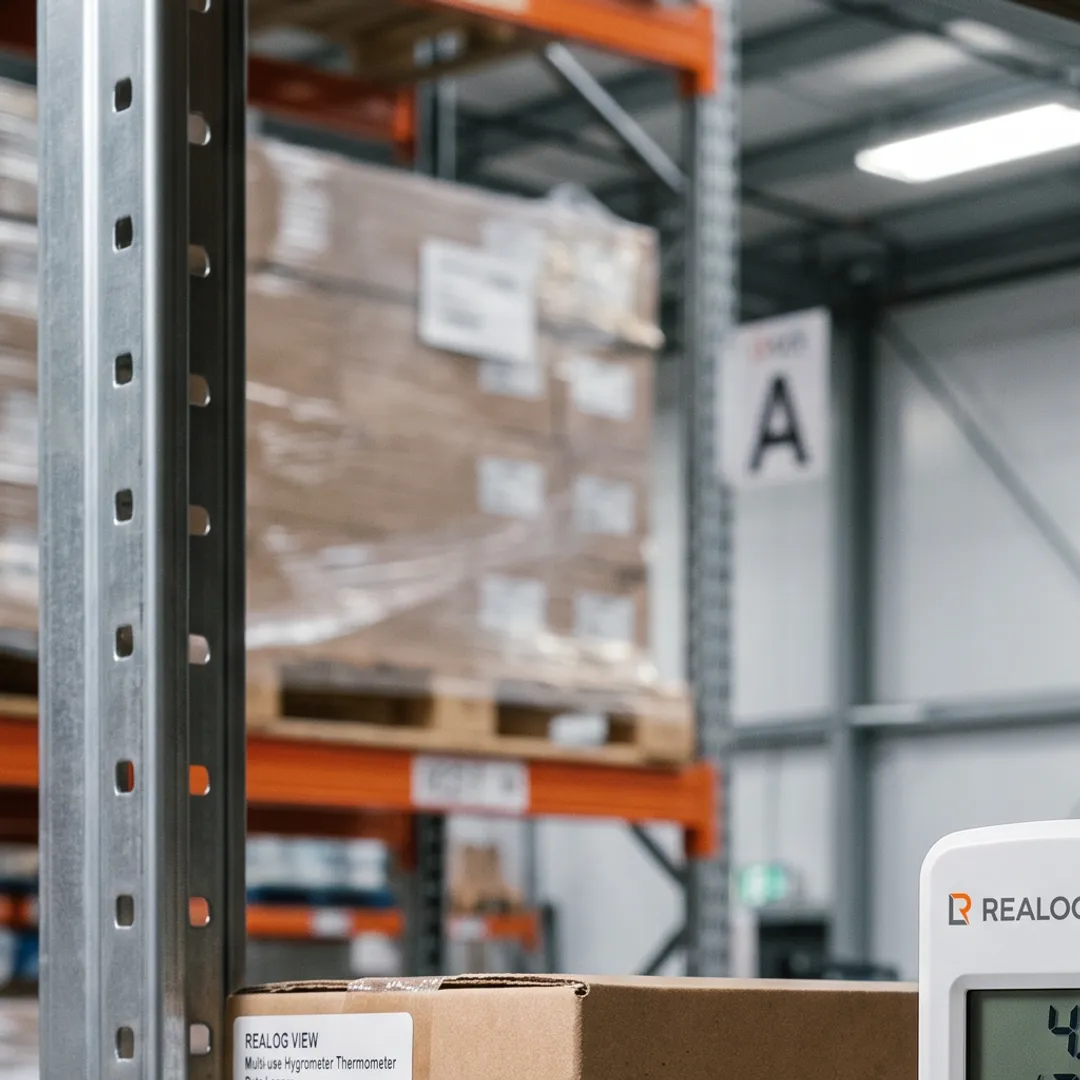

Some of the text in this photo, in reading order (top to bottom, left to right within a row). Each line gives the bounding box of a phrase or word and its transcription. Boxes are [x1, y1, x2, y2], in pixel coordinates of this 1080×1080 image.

[750, 374, 808, 472] A
[245, 1032, 319, 1049] REALOG VIEW
[285, 1056, 334, 1073] Hygrometer
[336, 1055, 396, 1070] Thermometer
